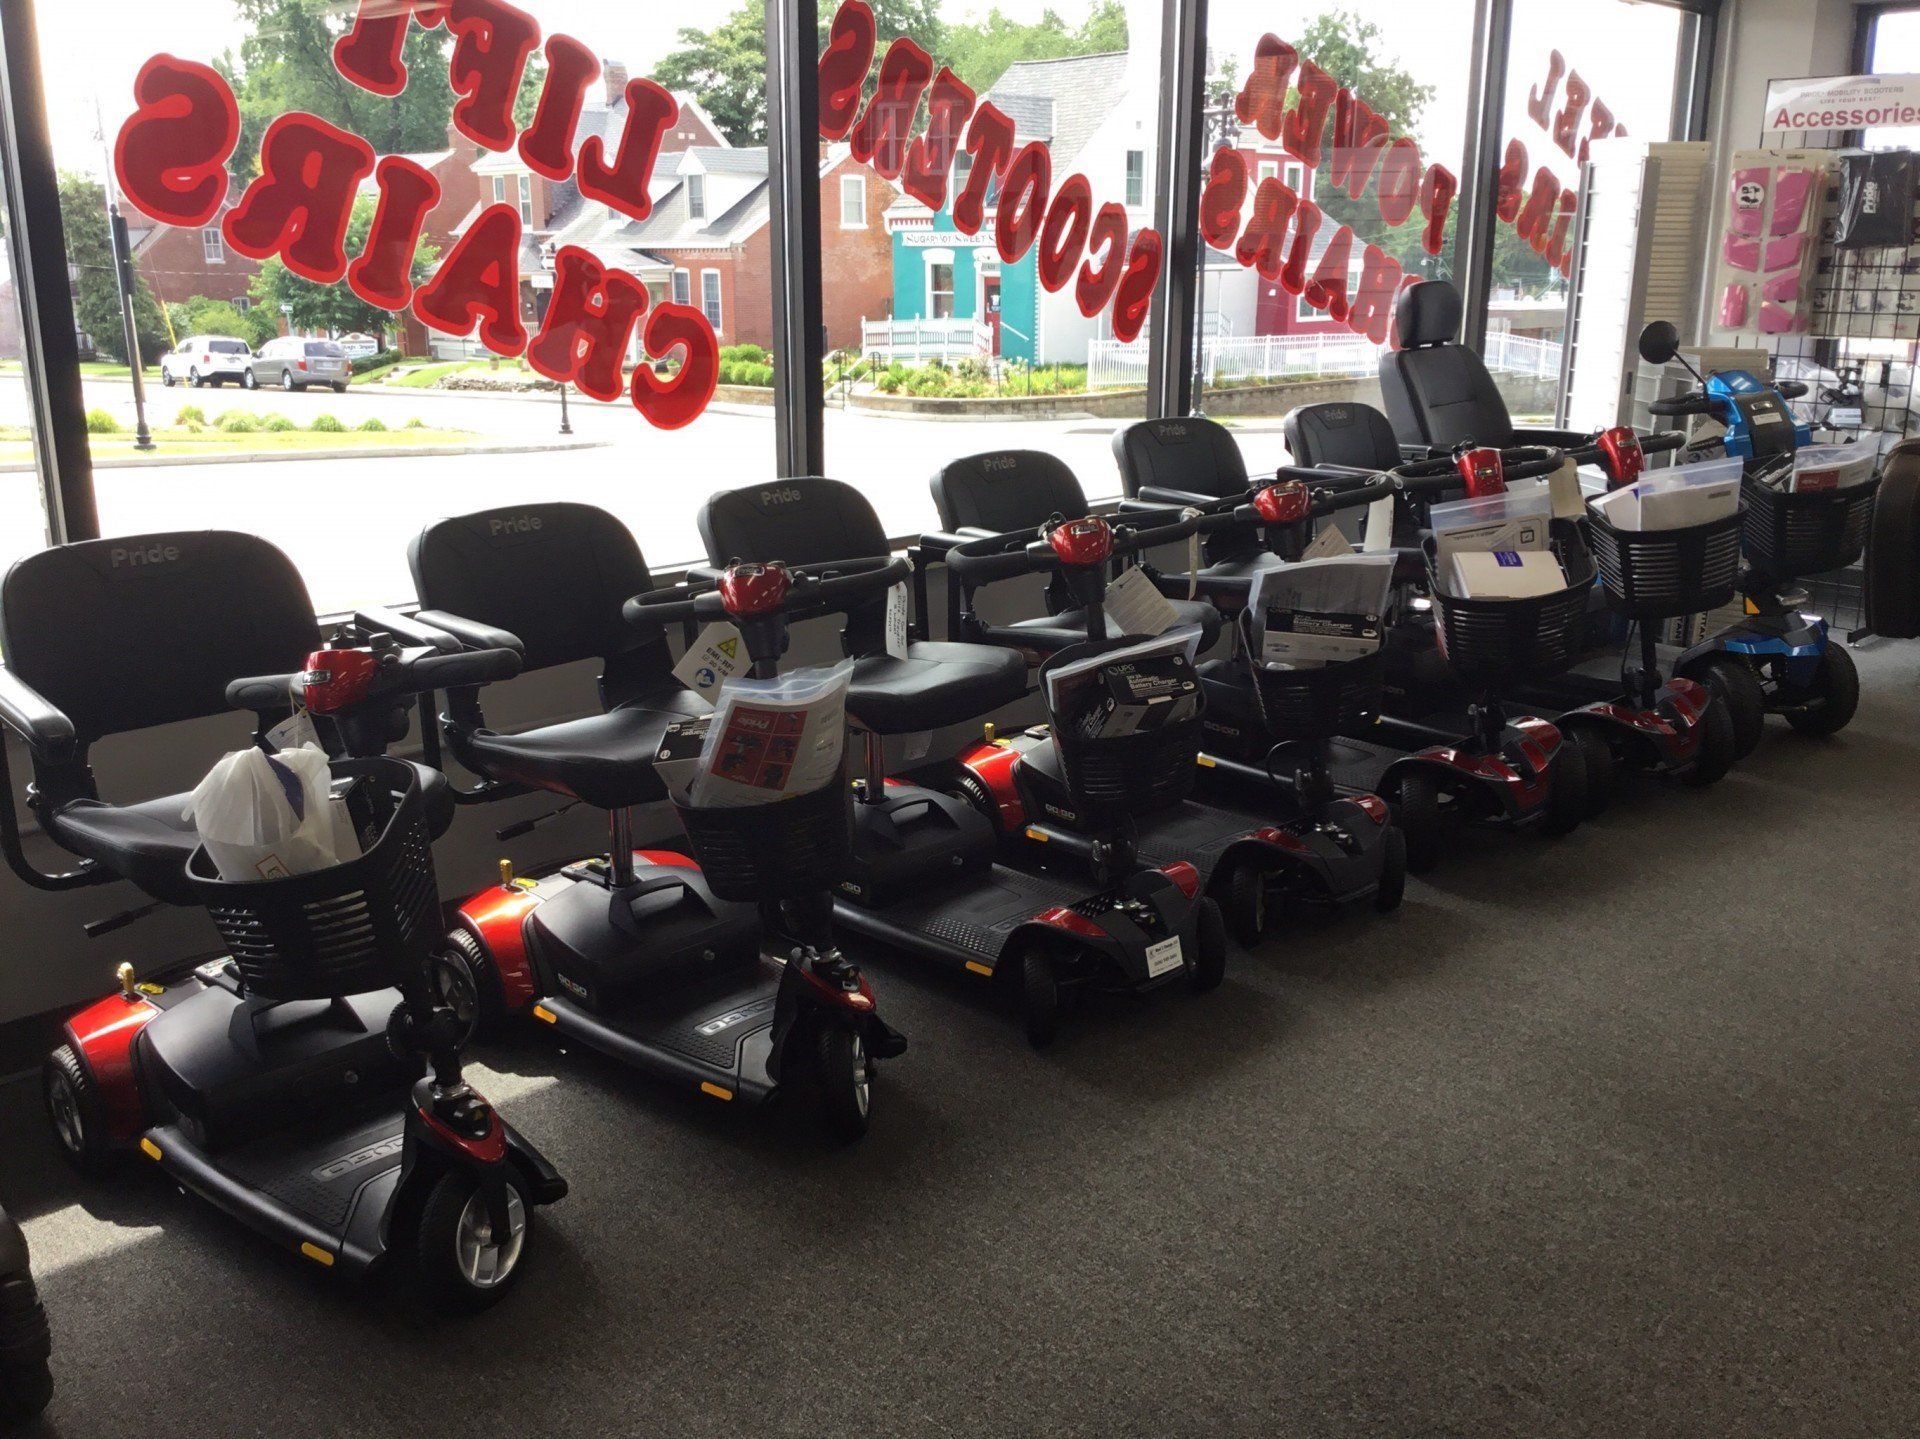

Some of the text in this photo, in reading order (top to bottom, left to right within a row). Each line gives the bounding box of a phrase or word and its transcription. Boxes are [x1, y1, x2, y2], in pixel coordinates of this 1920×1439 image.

[1827, 87, 1861, 97] MOBILITY
[1864, 86, 1905, 95] SCOOTERS
[1862, 181, 1878, 214] Pride
[1158, 423, 1187, 437] Pride
[983, 455, 1017, 472] Pride
[761, 488, 802, 506] Pride
[489, 514, 544, 536] Pride
[109, 545, 180, 569] Pride
[1675, 616, 1684, 639] TAN
[706, 647, 735, 672] EMI-RFI
[1152, 677, 1178, 687] Charger
